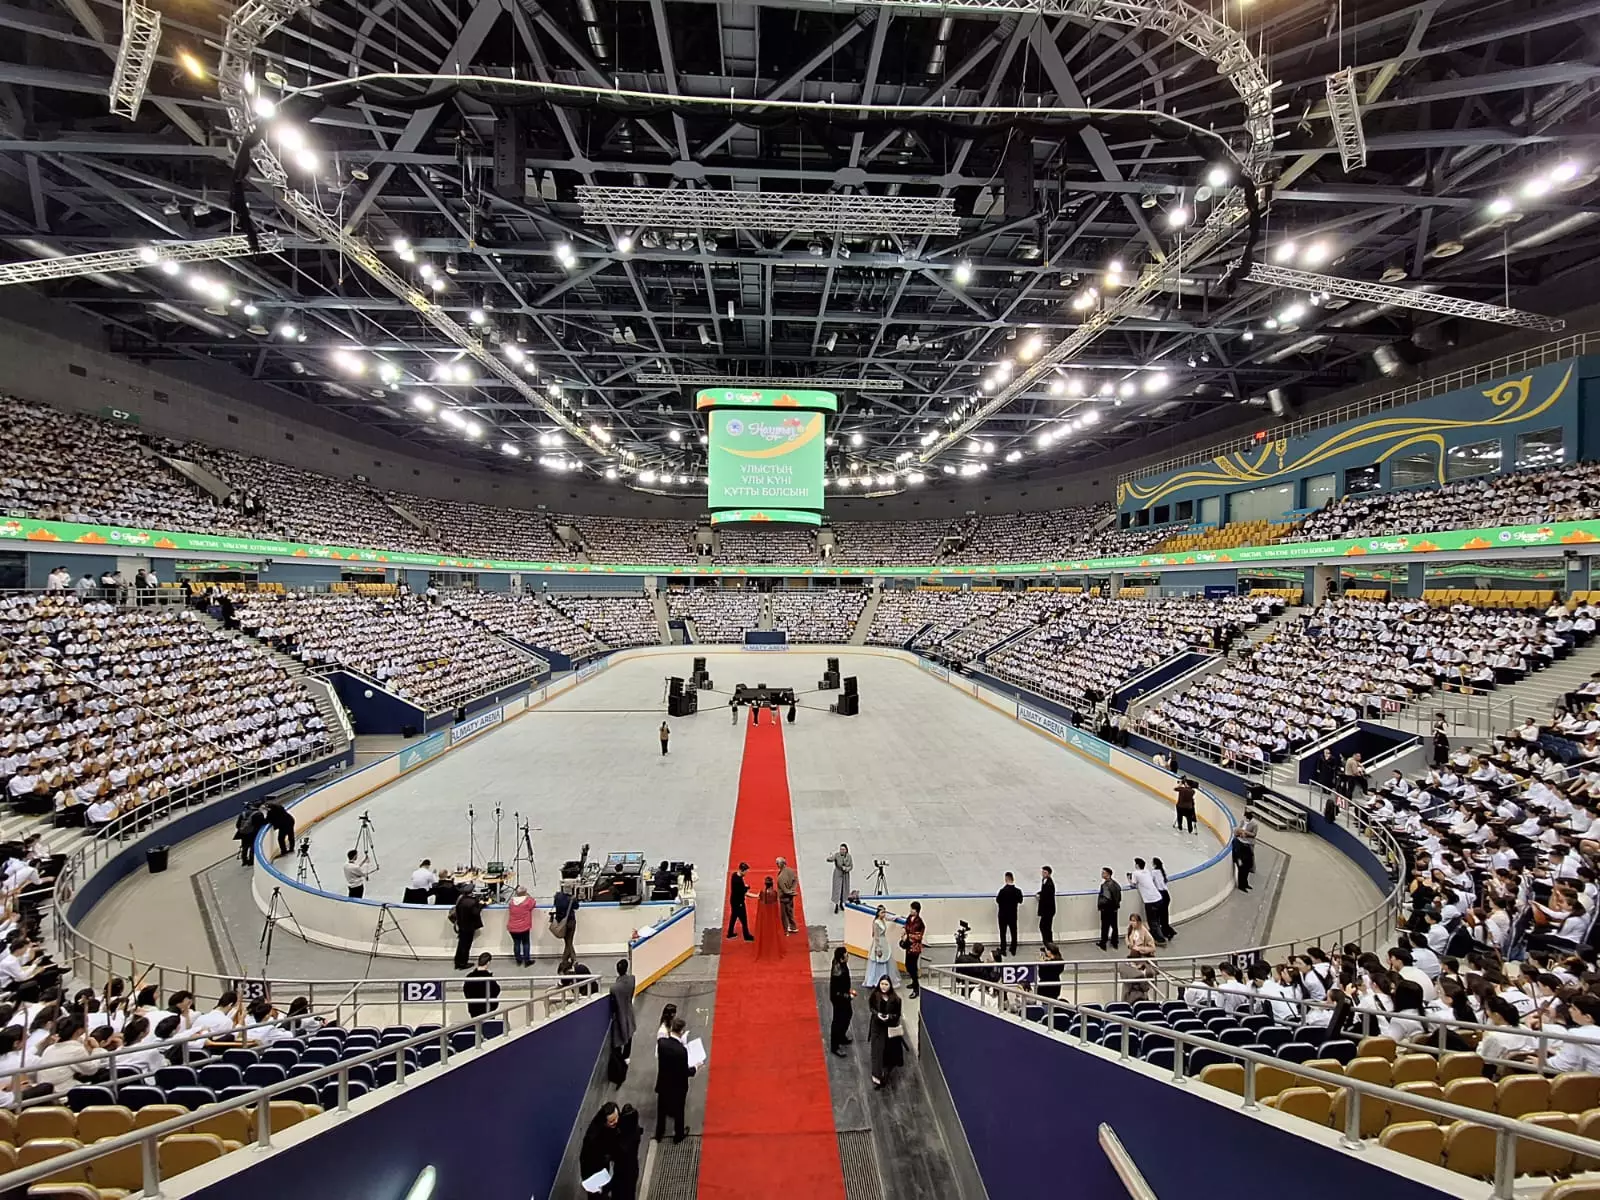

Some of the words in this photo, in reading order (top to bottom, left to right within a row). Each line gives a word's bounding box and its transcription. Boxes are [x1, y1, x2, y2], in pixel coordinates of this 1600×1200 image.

[112, 410, 129, 419] C7
[1384, 701, 1396, 710] A1
[480, 710, 501, 726] ARENA
[1020, 707, 1041, 724] ALMATY
[1043, 718, 1065, 738] ARENA
[1237, 952, 1255, 970] B1
[1003, 966, 1029, 984] B2
[237, 982, 264, 999] B3
[408, 982, 437, 1000] B2
